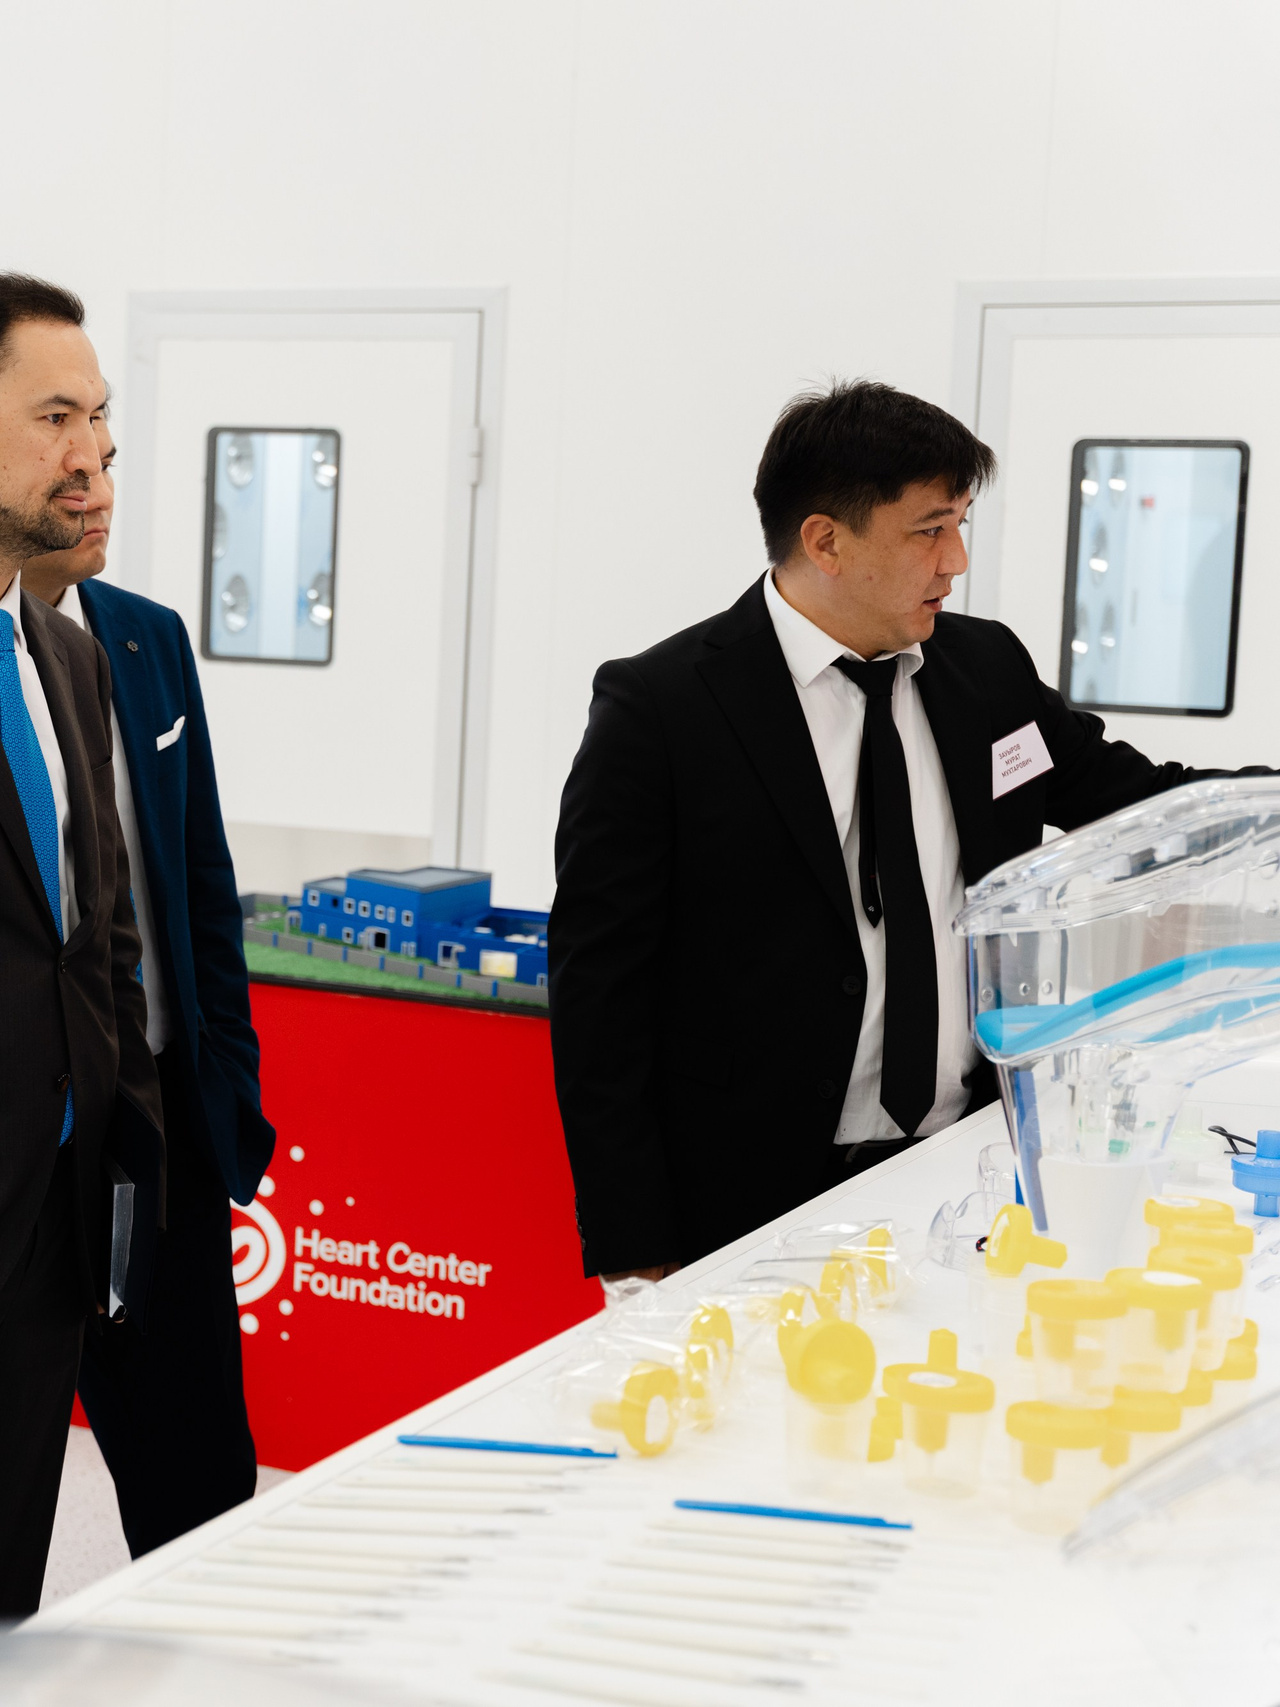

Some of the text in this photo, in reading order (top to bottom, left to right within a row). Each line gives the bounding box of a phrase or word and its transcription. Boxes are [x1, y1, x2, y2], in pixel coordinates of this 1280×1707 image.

[1001, 757, 1032, 778] МУХТАРОВИЧ
[1005, 753, 1021, 766] МУРАТ
[294, 1226, 492, 1287] Heart Center
[293, 1261, 465, 1320] Foundation
